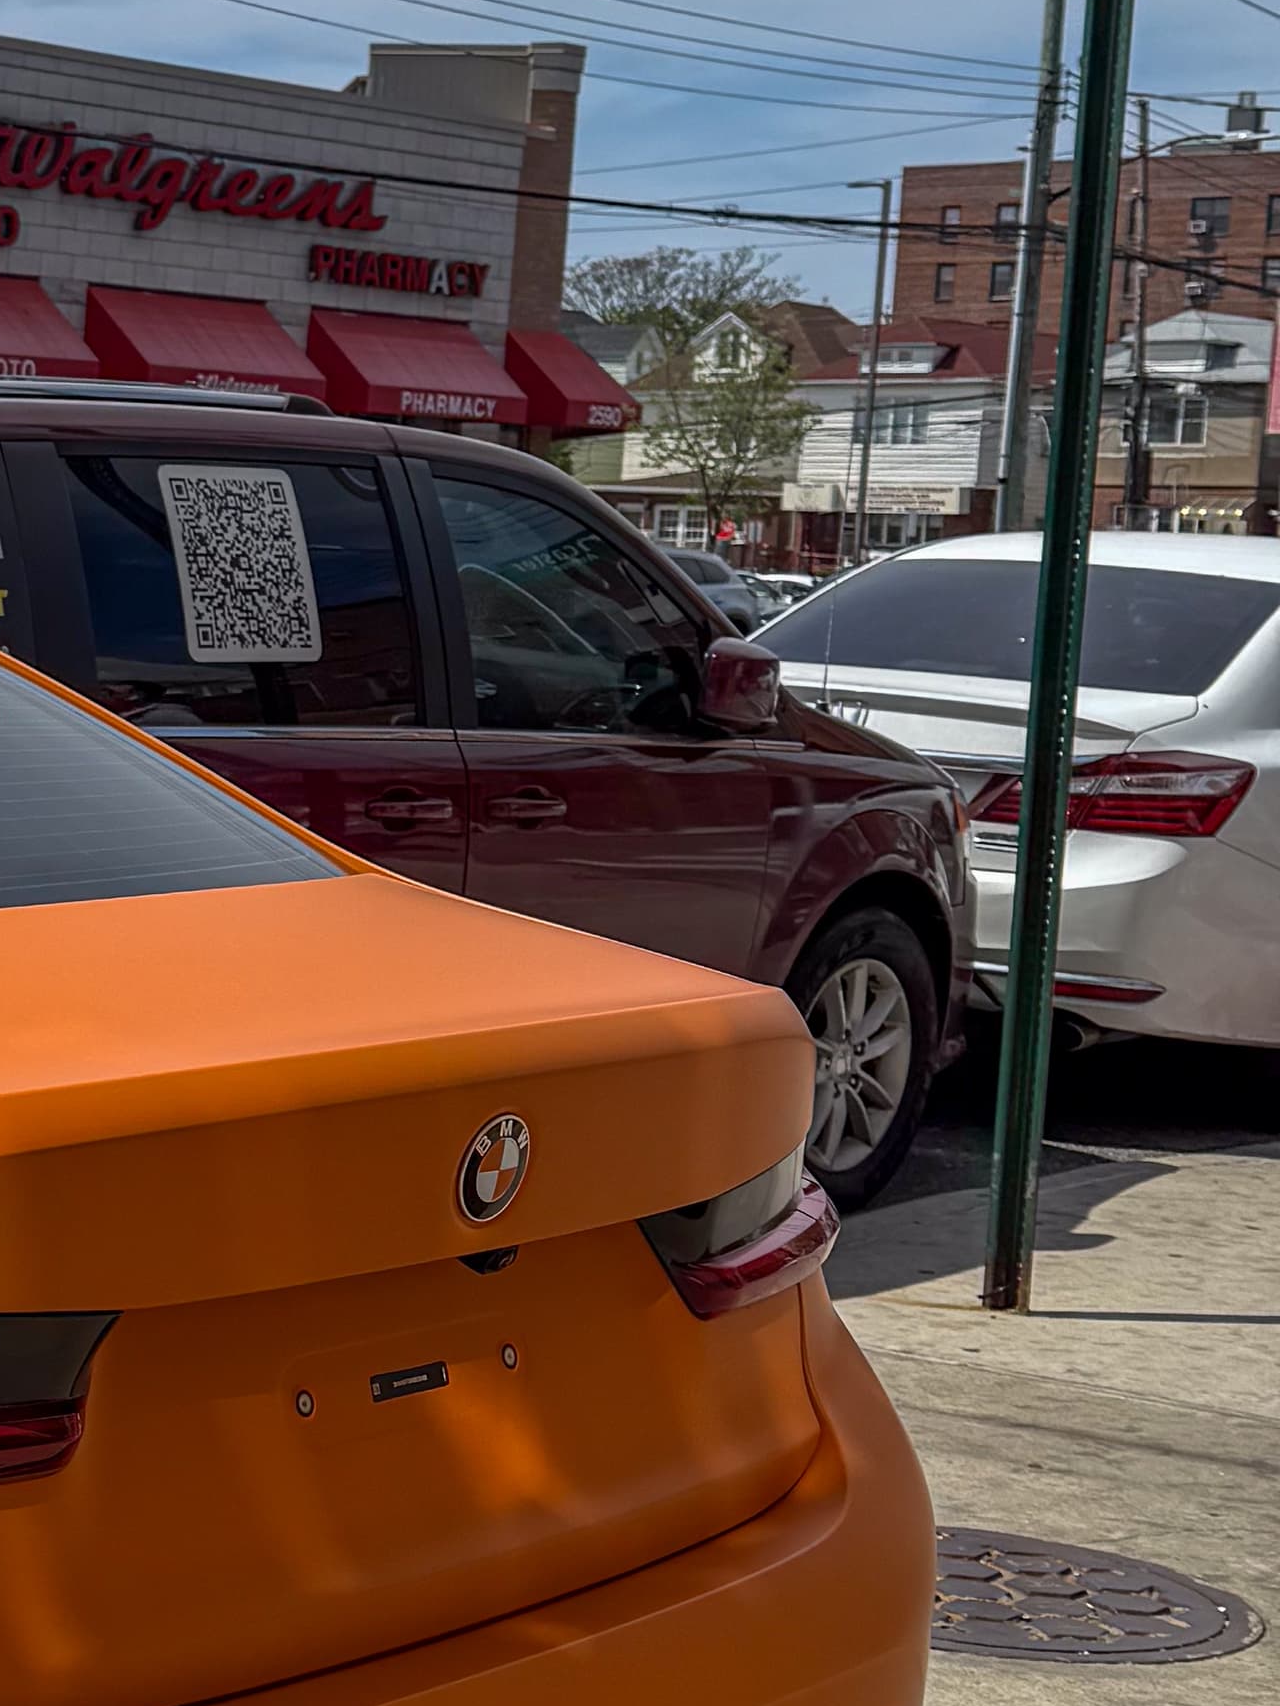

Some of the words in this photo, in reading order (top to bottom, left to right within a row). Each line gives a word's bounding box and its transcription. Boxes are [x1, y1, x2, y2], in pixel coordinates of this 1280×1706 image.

[310, 244, 489, 298] PHARMACY
[401, 391, 497, 419] PHARMACY
[475, 1119, 530, 1157] BMW
